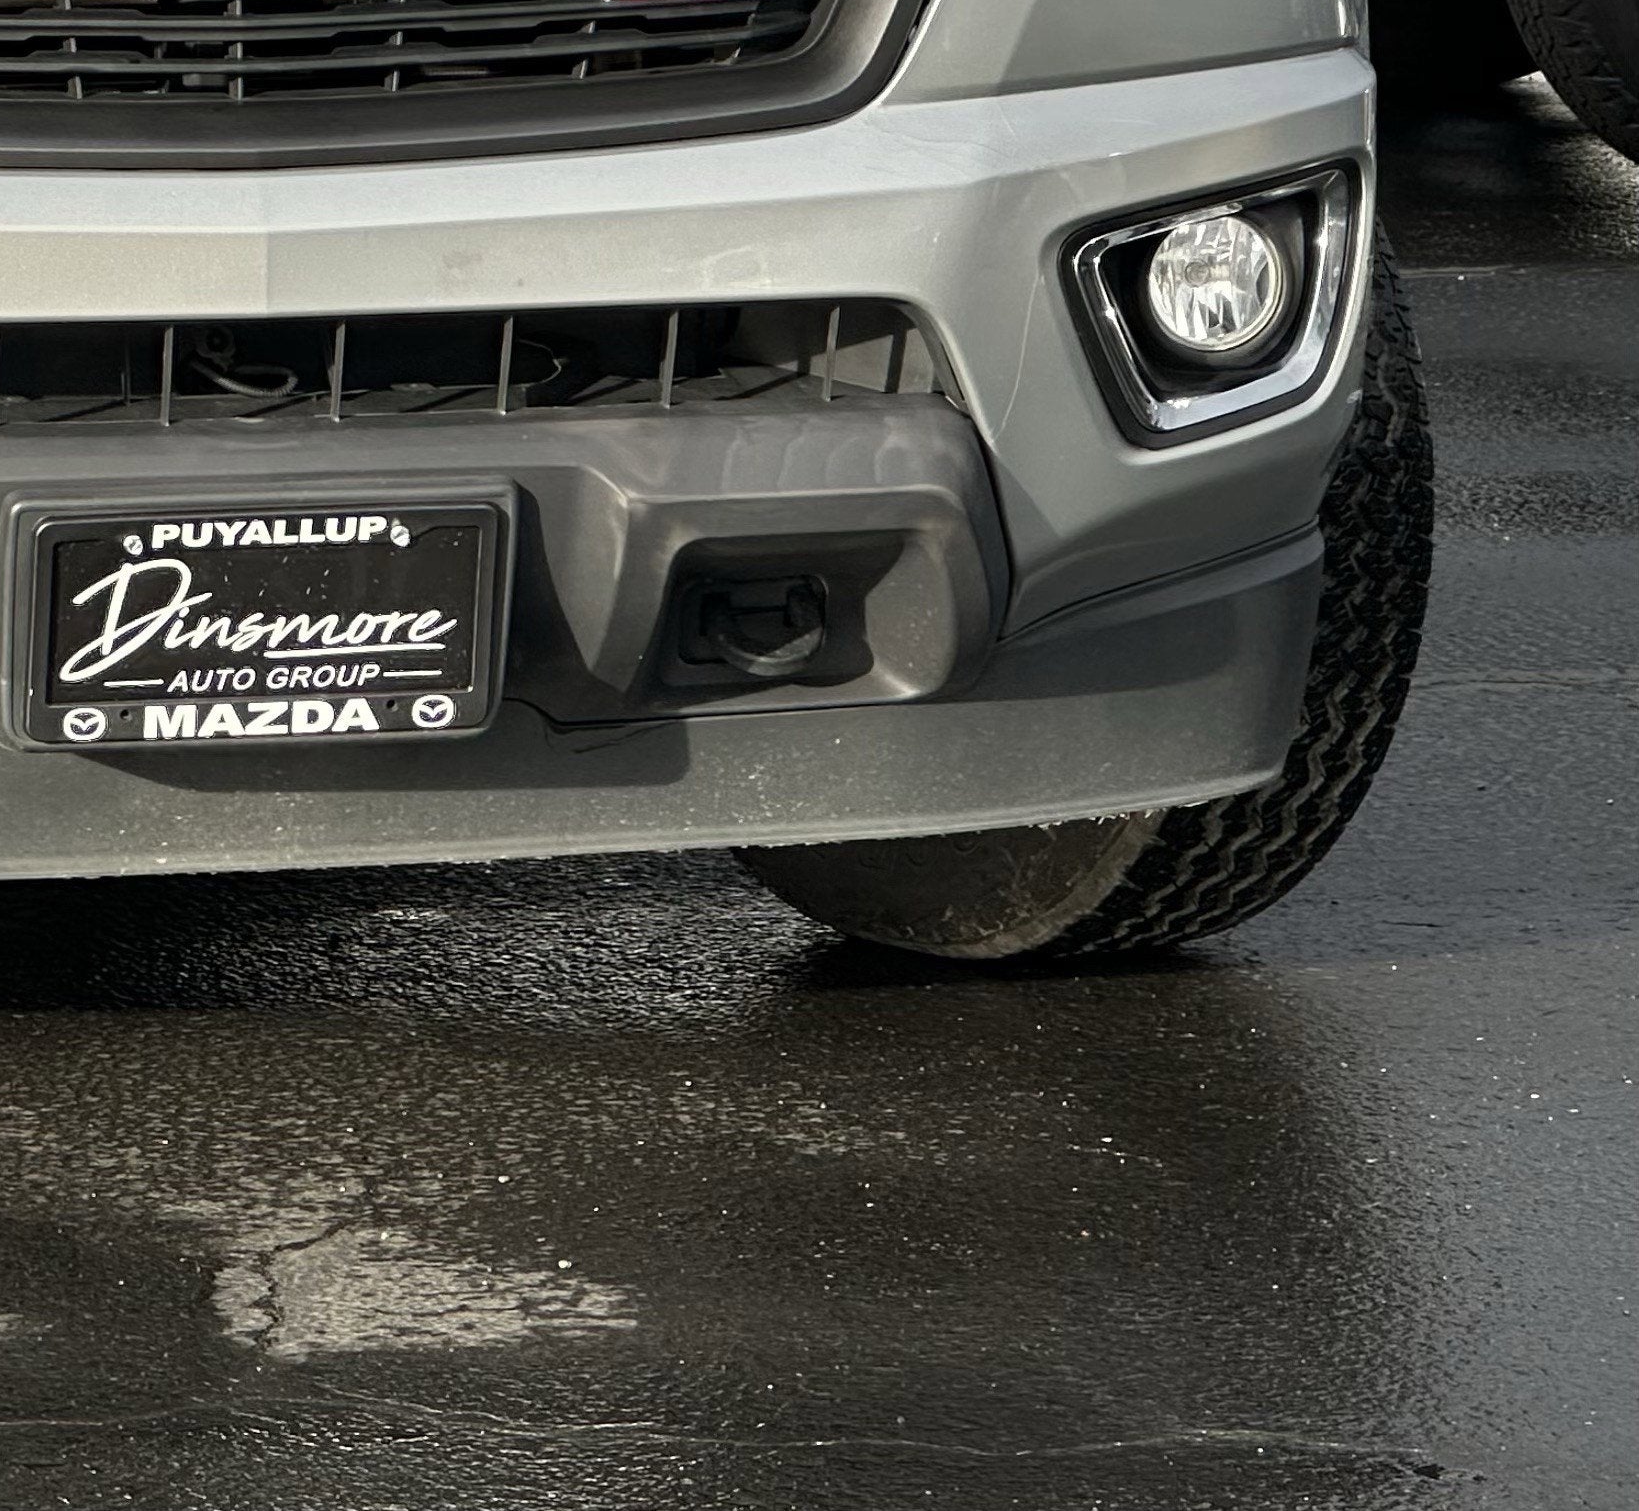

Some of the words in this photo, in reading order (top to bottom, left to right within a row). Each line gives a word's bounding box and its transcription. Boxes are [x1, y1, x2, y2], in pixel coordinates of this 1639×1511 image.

[151, 515, 388, 549] PUYALLUP
[59, 558, 457, 683] Dinsmore
[167, 667, 256, 693] AUTO
[266, 664, 381, 690] GROUP
[142, 698, 380, 740] MAZDA
